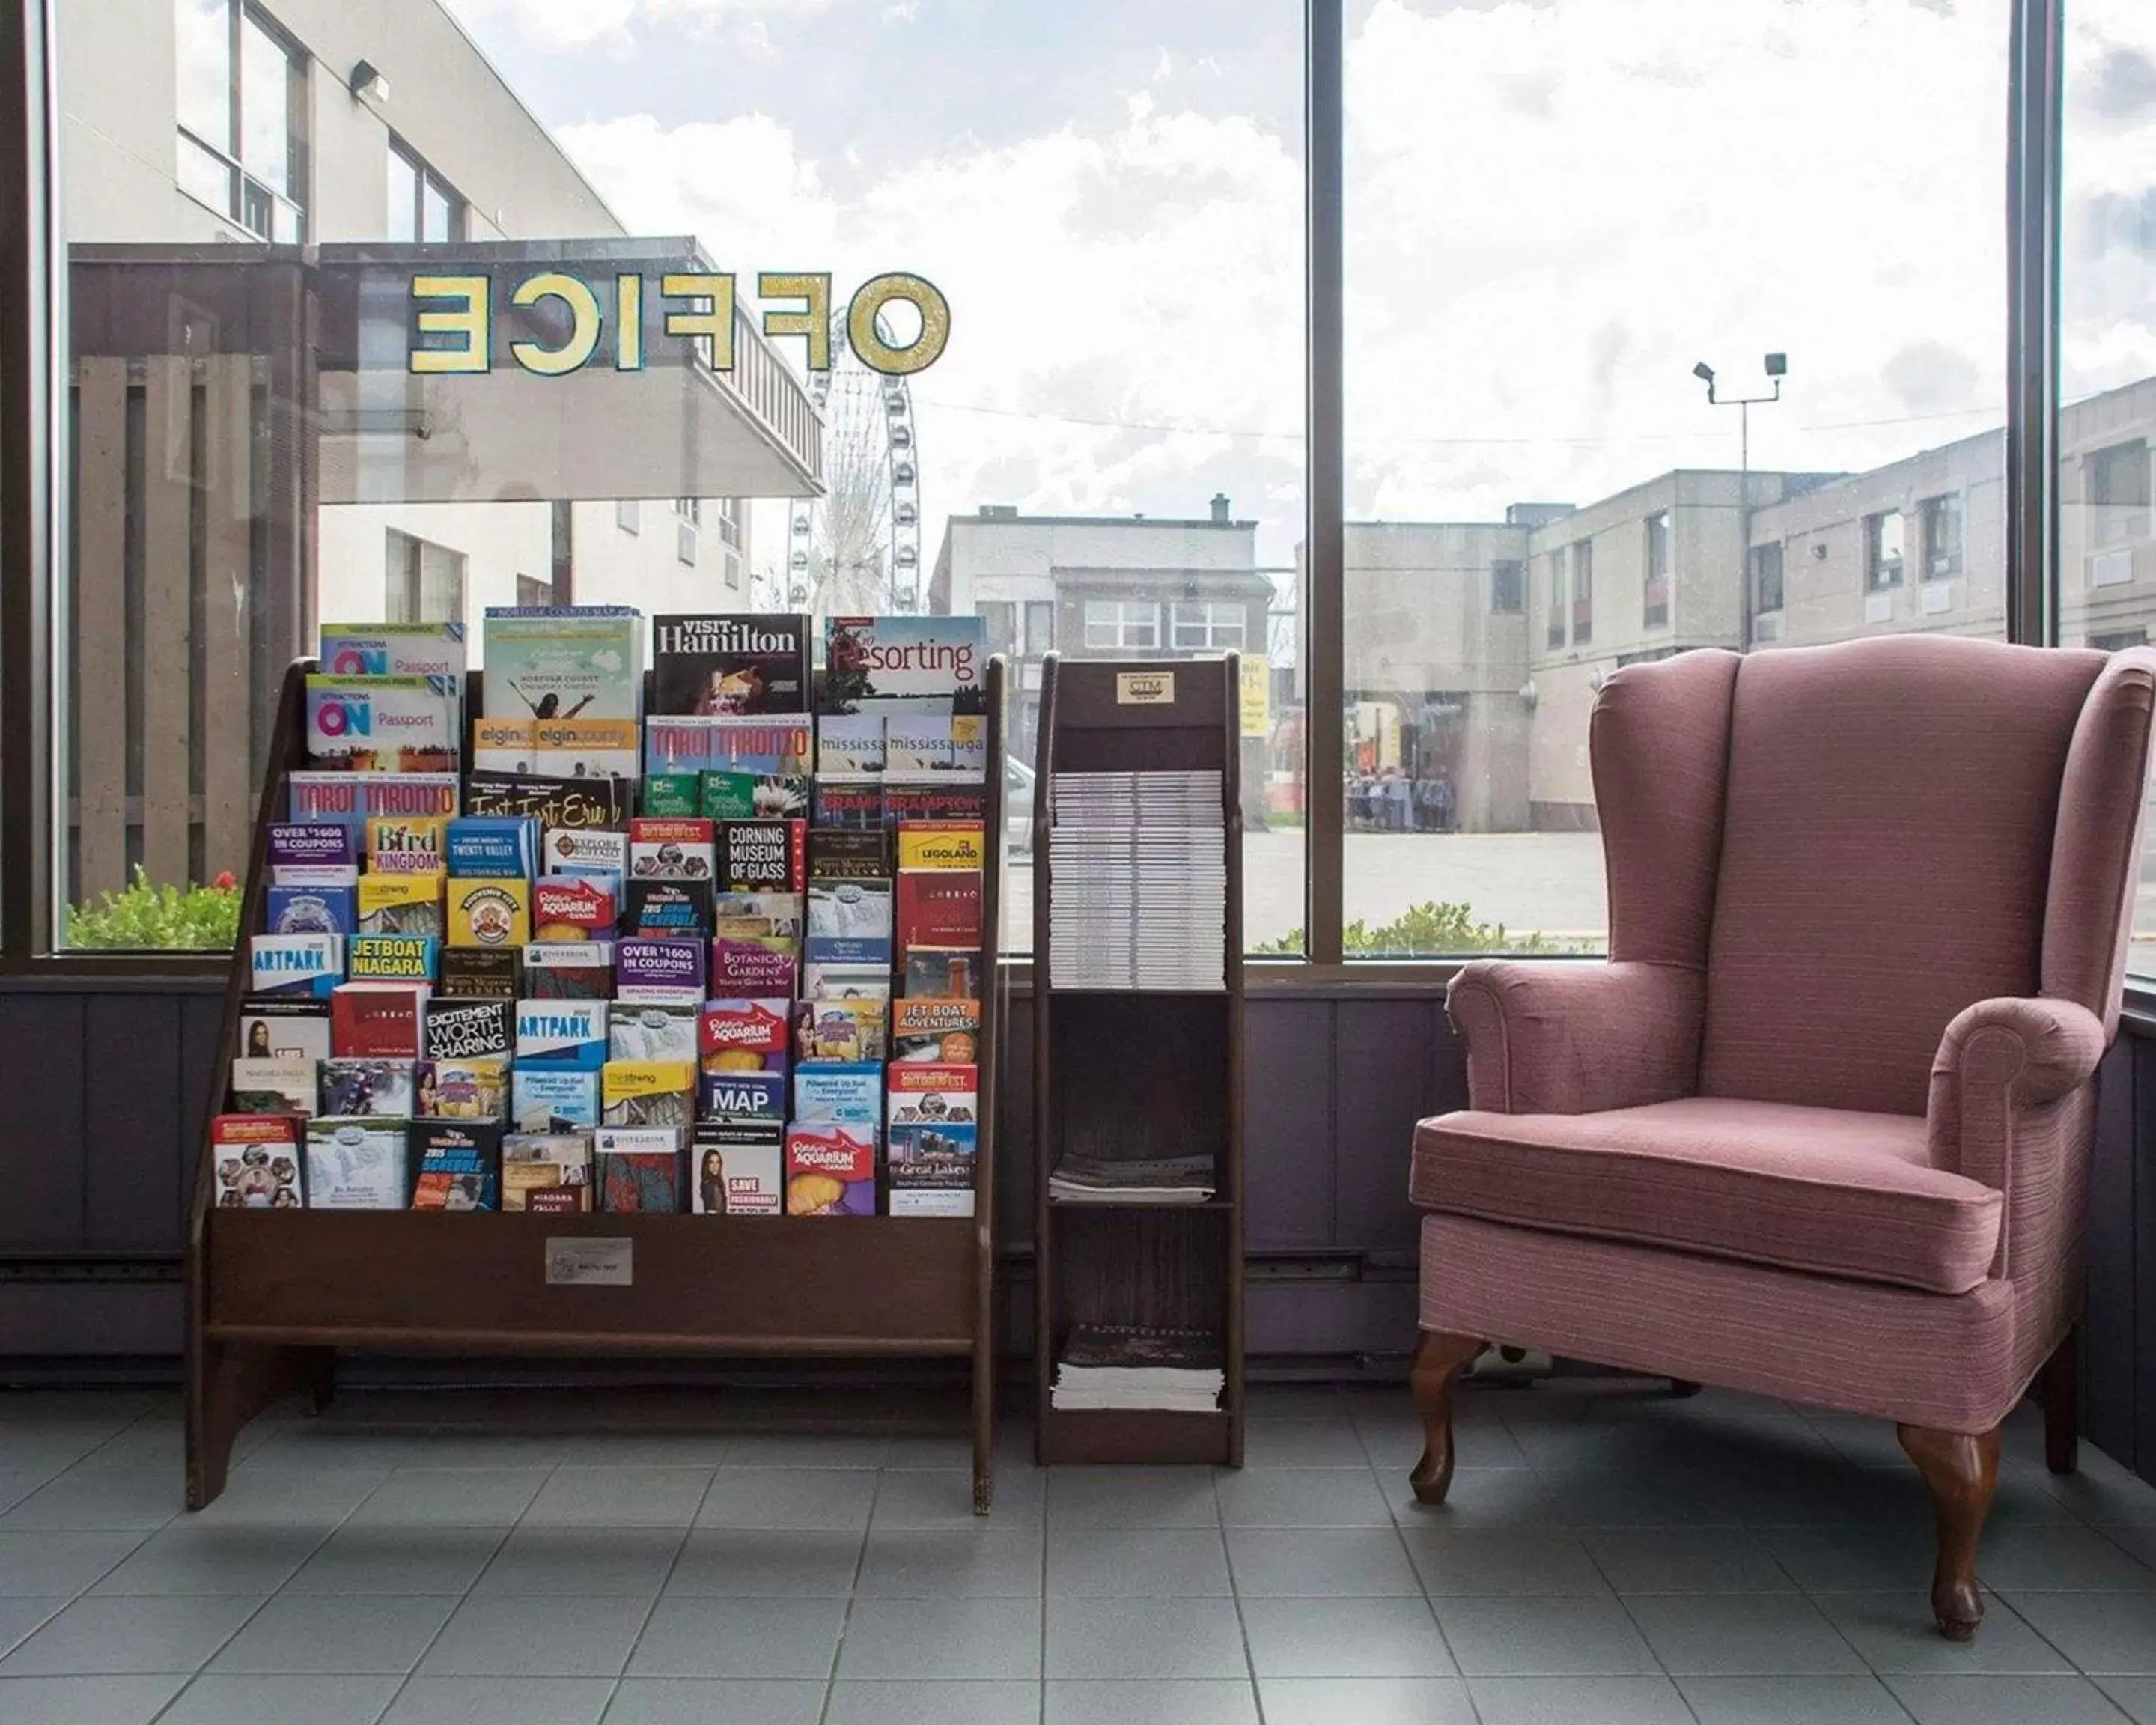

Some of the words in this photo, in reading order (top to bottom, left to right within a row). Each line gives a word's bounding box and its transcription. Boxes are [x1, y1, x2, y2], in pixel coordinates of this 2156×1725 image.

[683, 620, 731, 633] VISIT
[659, 624, 796, 654] Hamilton
[335, 649, 387, 675] ON
[318, 702, 370, 737] ON
[378, 713, 433, 729] Passport
[481, 726, 521, 746] elgin
[716, 726, 807, 756] TORONTO
[821, 736, 886, 749] mississa
[890, 736, 984, 753] mississauga
[362, 785, 454, 813] TORONTO
[889, 796, 981, 811] BRAMPTON
[272, 827, 307, 838] OVER
[377, 824, 436, 851] Bird
[729, 827, 785, 843] CORNING
[274, 839, 287, 848] IN
[289, 839, 344, 849] COUPONS
[376, 852, 440, 870] KINGDOM
[730, 845, 785, 862] MUSEUM
[922, 849, 978, 859] LEGOLAND
[731, 862, 744, 879] OF
[746, 862, 786, 880] GLASS
[353, 937, 426, 957] JETBOAT
[623, 946, 657, 957] OVER
[255, 949, 325, 971] ARTPARK
[353, 958, 425, 975] NIAGARA
[624, 959, 636, 969] IN
[639, 959, 695, 971] COUPONS
[428, 1004, 503, 1028] EXCITEMENT
[906, 1006, 926, 1017] JET
[933, 1005, 967, 1017] BOAT
[429, 1017, 504, 1044] WORTH
[519, 1016, 591, 1038] ARTPARK
[714, 1025, 772, 1041] AQUARIUM
[429, 1035, 506, 1059] SHARING
[713, 1090, 769, 1112] MAP
[795, 1150, 854, 1166] AQUARIUM
[900, 1164, 934, 1175] Great
[731, 1179, 758, 1192] SAVE
